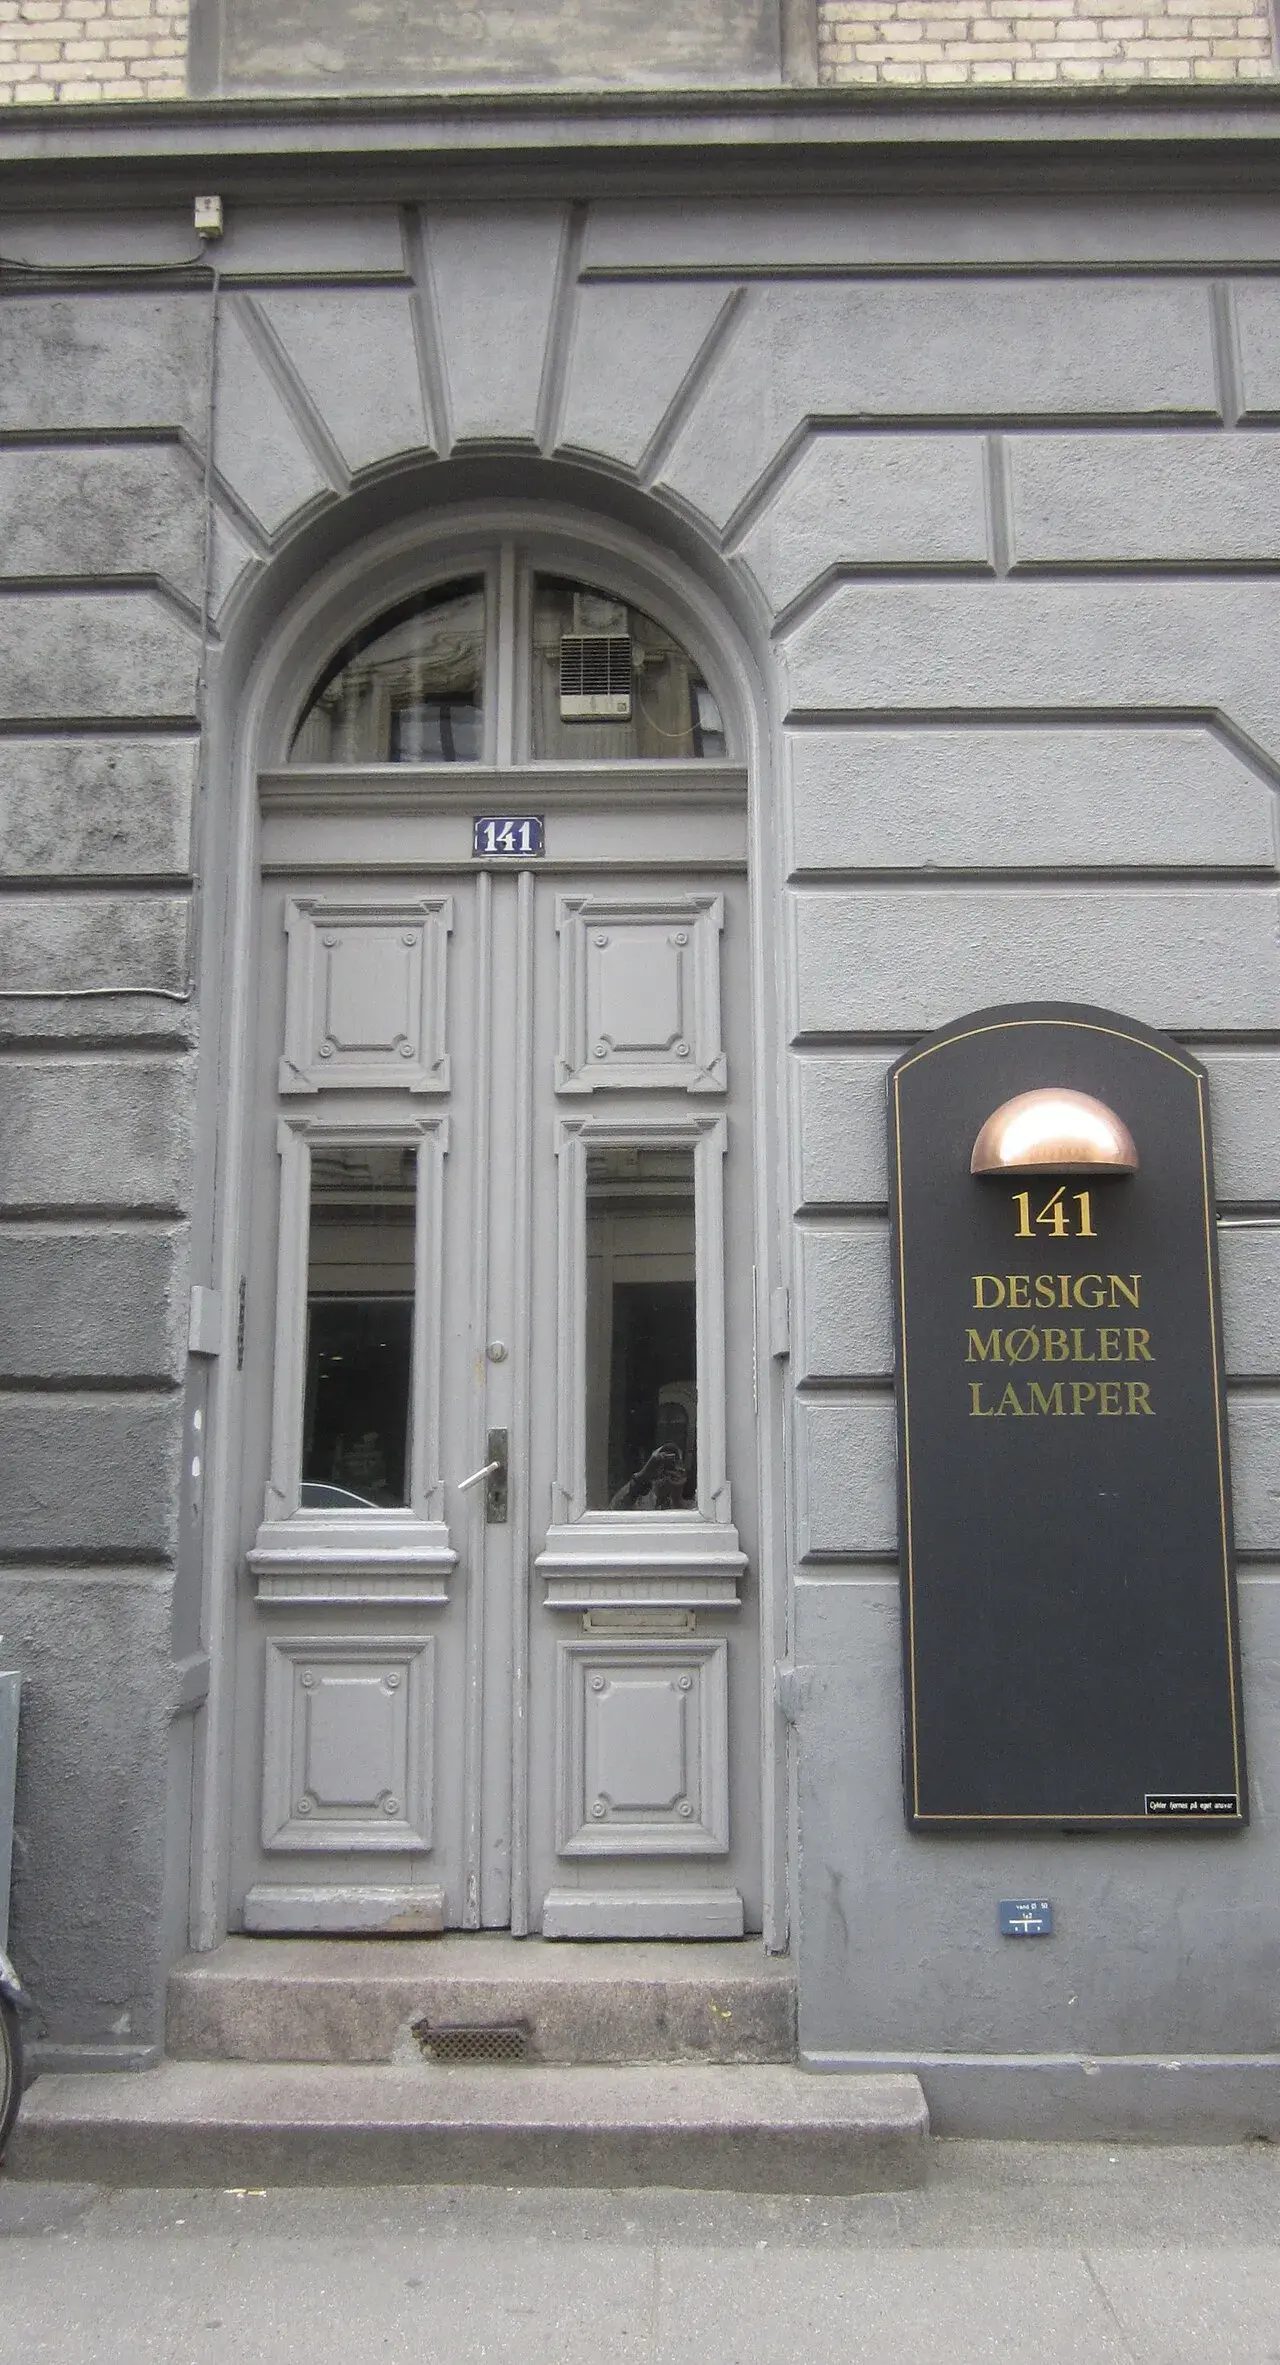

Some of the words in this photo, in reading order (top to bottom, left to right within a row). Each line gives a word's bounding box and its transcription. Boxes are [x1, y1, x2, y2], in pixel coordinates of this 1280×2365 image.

[484, 821, 532, 851] 141
[1012, 1186, 1097, 1237] 141
[972, 1275, 1142, 1308] DESIGN
[964, 1324, 1155, 1366] MØBLER
[968, 1382, 1155, 1416] LAMPER
[1149, 1801, 1167, 1810] Cykler
[1169, 1801, 1188, 1810] fjernes
[1190, 1801, 1198, 1810] på
[1199, 1802, 1212, 1810] eget
